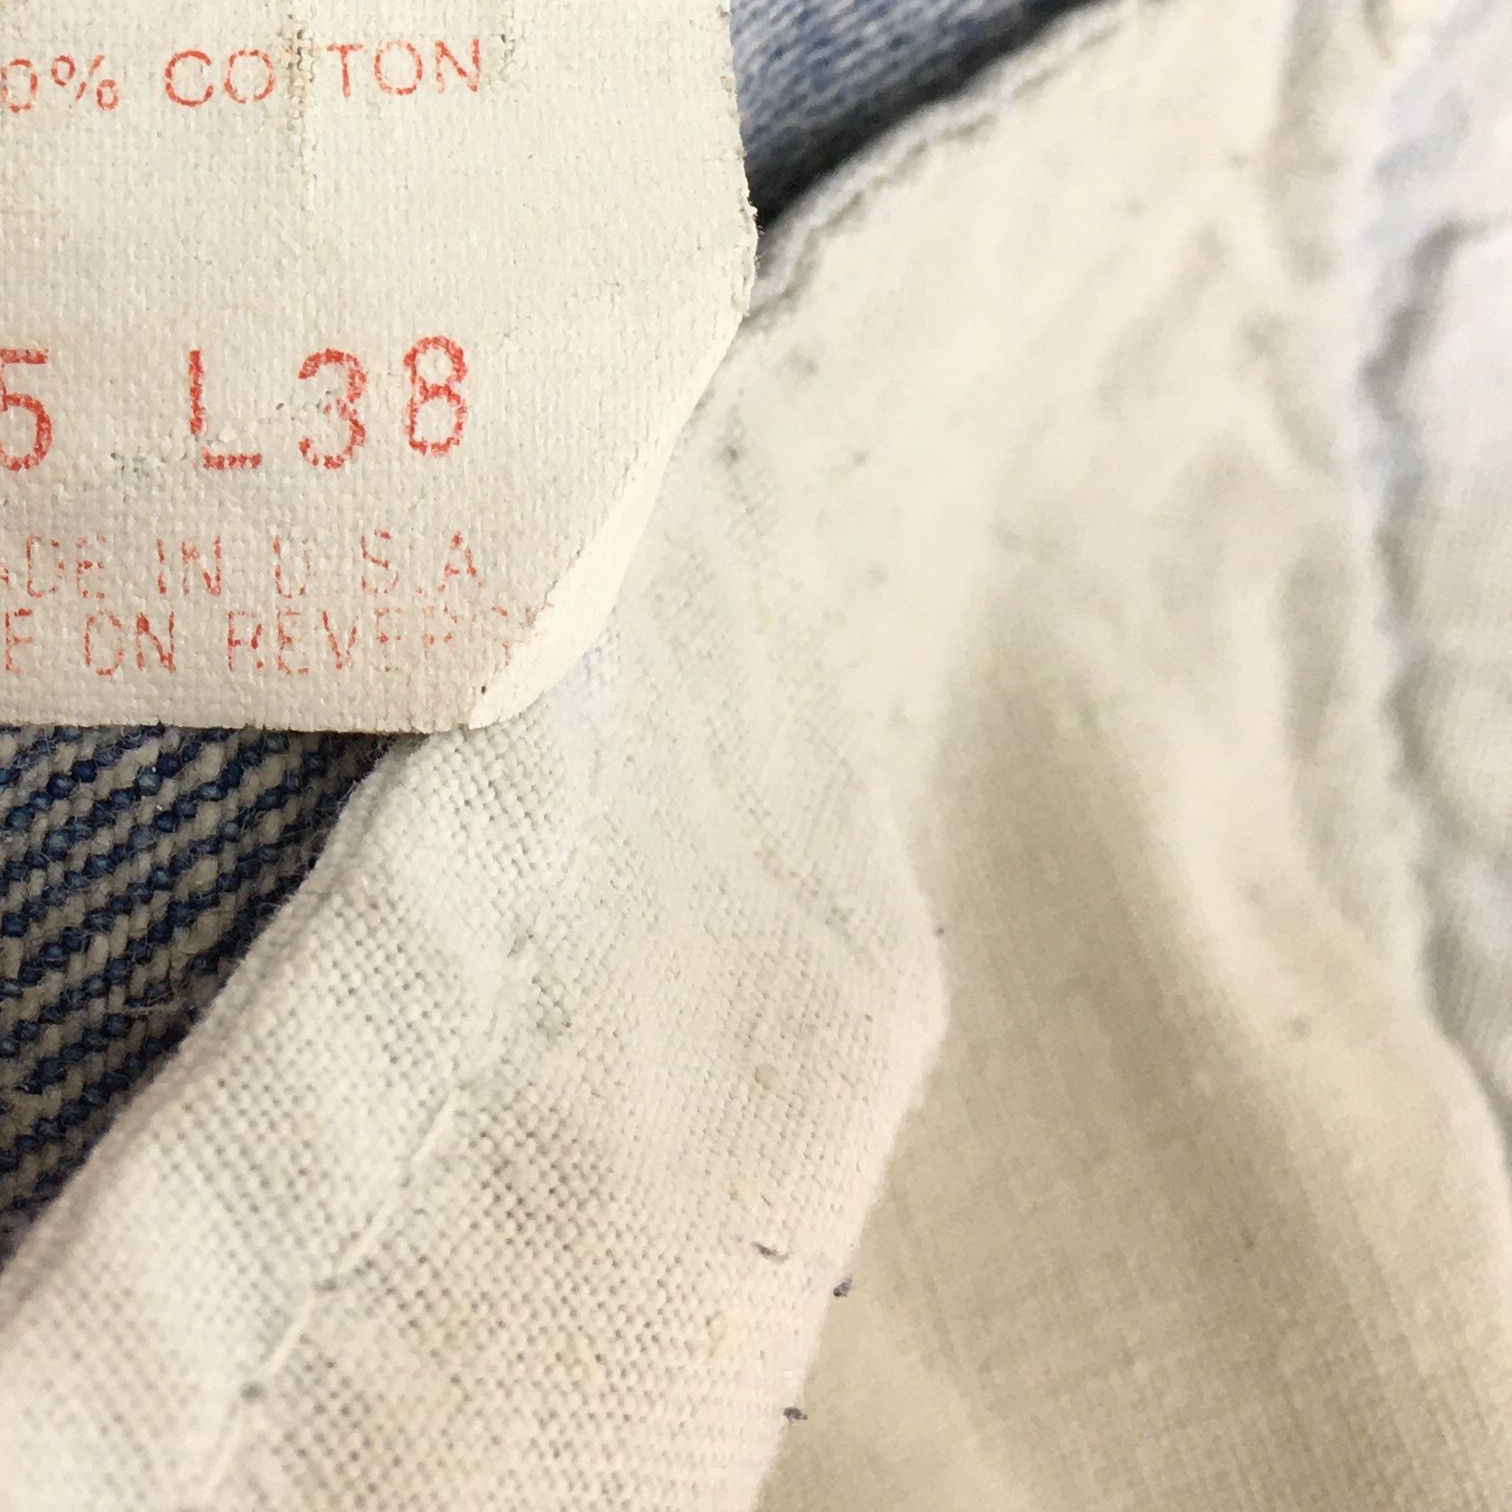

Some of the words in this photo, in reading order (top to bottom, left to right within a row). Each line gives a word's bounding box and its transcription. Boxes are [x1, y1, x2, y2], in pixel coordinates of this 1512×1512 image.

[164, 39, 483, 108] COTON
[156, 535, 222, 596] IN
[86, 608, 176, 675] ON
